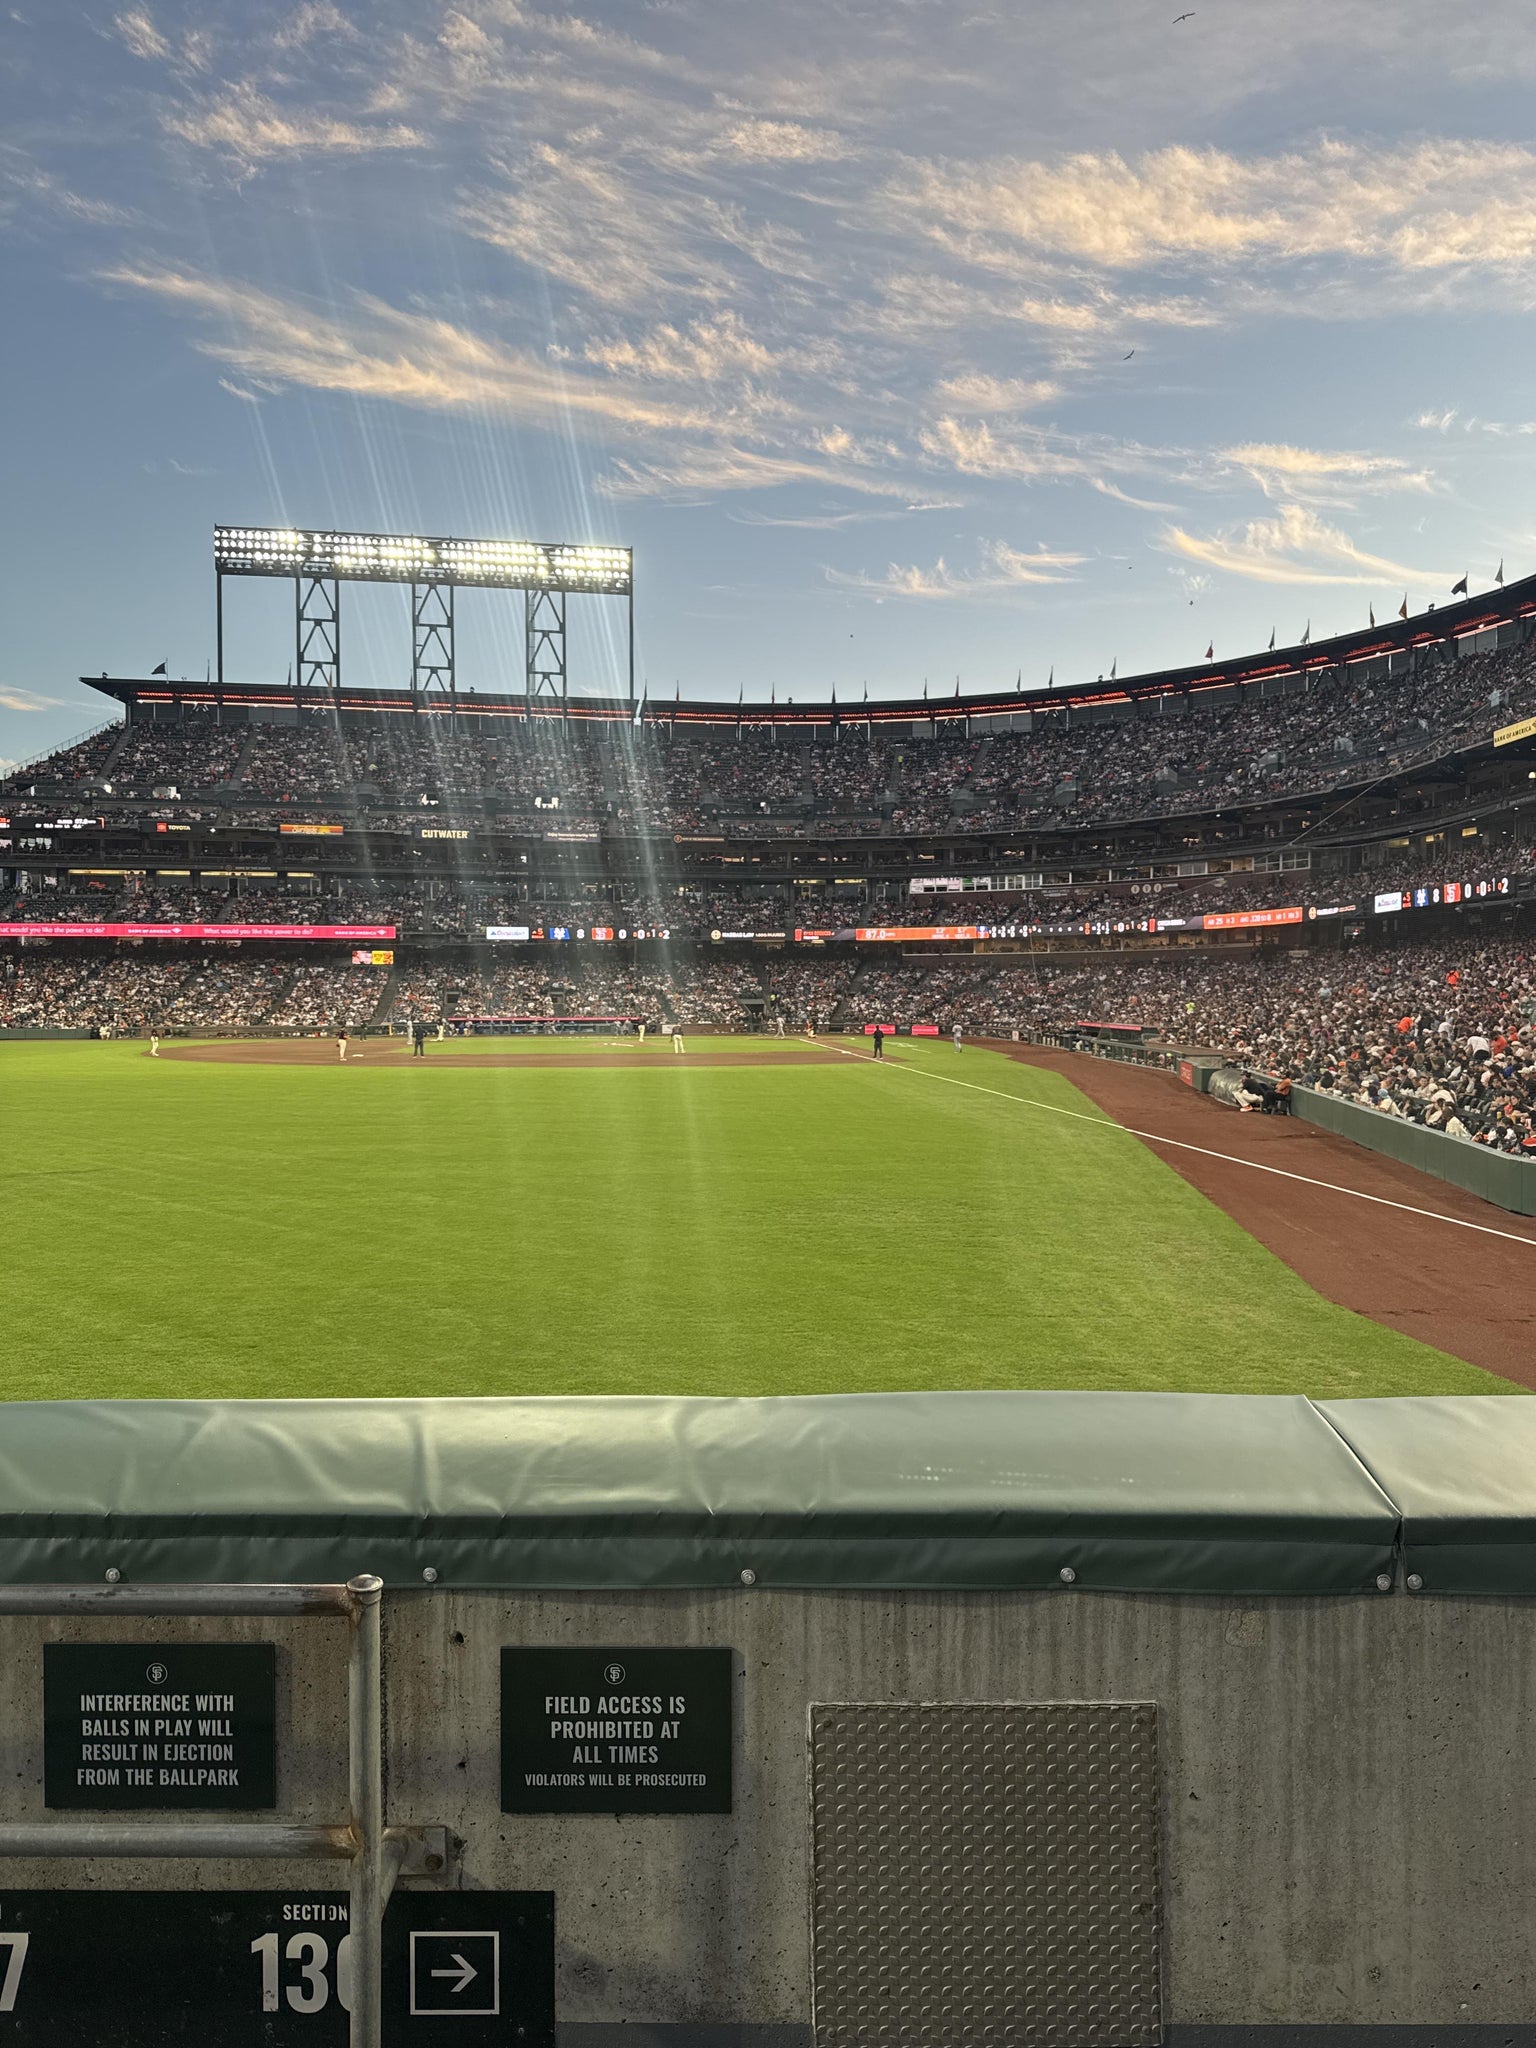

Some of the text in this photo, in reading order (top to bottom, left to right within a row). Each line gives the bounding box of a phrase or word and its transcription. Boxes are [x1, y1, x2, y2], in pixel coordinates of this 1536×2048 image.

[1494, 734, 1506, 743] BANK
[1512, 725, 1532, 737] AMERICA
[421, 829, 468, 839] CUTWATER
[1432, 888, 1440, 903] 8
[1464, 883, 1472, 899] 0
[1480, 881, 1487, 897] 0
[1491, 878, 1496, 892] 1
[1501, 877, 1509, 894] 2
[576, 928, 584, 939] 8
[618, 929, 627, 939] 0
[663, 929, 670, 940] 2
[80, 1694, 234, 1712] INTERFERENCE WITH
[545, 1696, 686, 1715] FIELD ACCESS IS
[82, 1719, 234, 1737] BALLS IN PLAY WILL
[551, 1720, 681, 1739] PROHIBITED AT
[82, 1744, 233, 1761] RESULT IN EJECTION
[572, 1745, 659, 1764] ALL TIMES
[77, 1768, 239, 1786] FROM THE BALLPARK
[524, 1773, 707, 1787] VIOLATORS WILL BE PROSECUTED
[283, 1904, 348, 1921] SECTION
